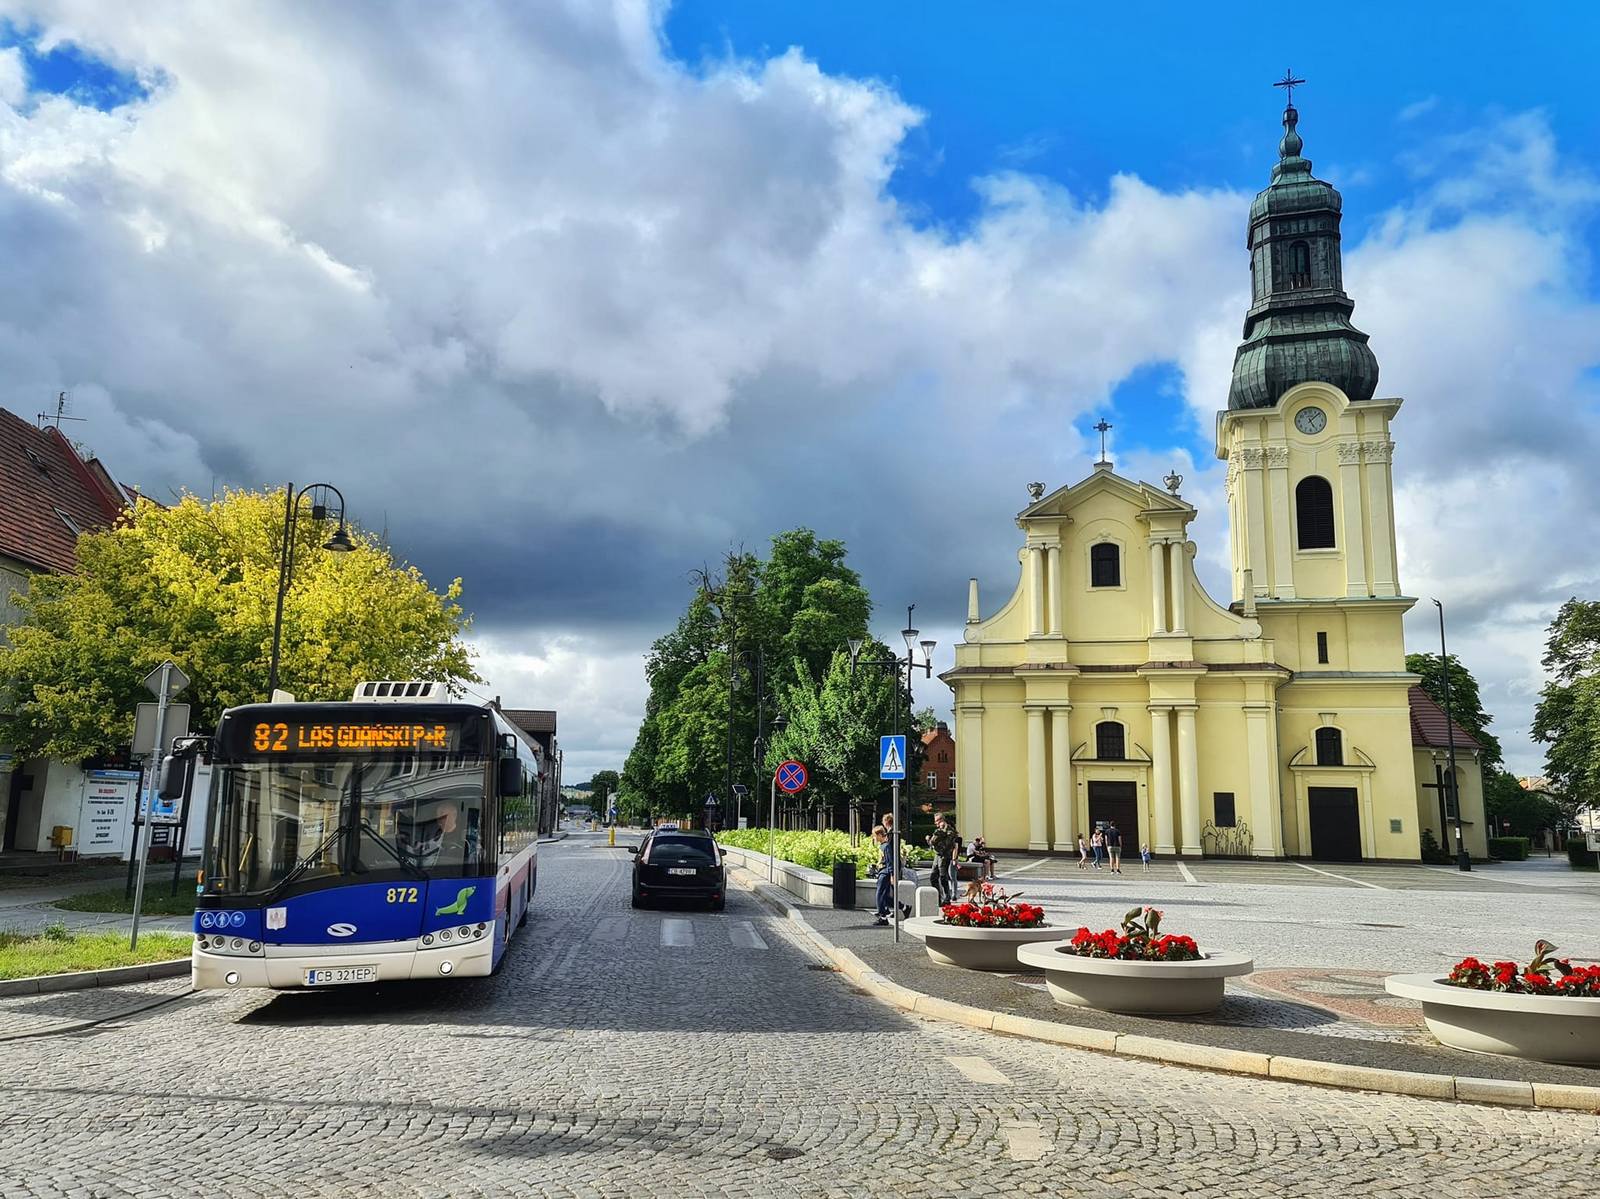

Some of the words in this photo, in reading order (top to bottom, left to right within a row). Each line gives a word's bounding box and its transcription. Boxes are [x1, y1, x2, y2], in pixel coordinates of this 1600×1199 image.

[254, 723, 289, 751] 82
[298, 726, 334, 748] LAS
[412, 725, 447, 747] P+R
[386, 887, 418, 903] 872
[316, 970, 333, 983] CB
[336, 968, 371, 982] 321EP
